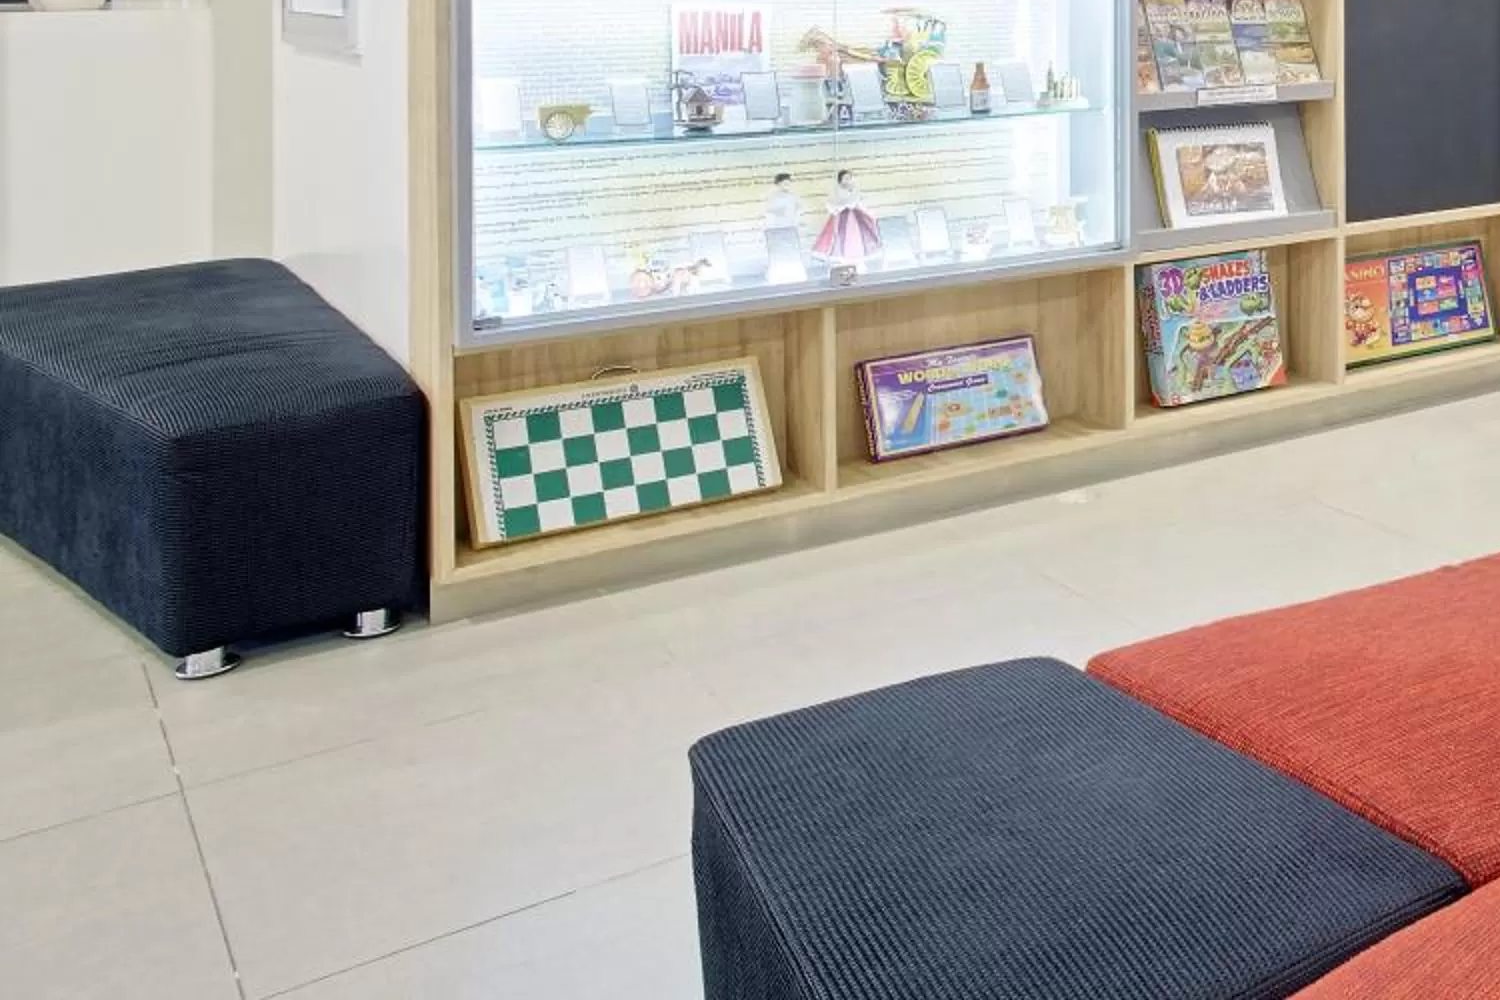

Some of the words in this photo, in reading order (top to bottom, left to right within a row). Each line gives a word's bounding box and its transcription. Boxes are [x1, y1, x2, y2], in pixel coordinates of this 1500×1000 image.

[678, 9, 764, 55] MANILA
[1201, 260, 1250, 280] SNAKES
[1211, 275, 1269, 298] LADDERS
